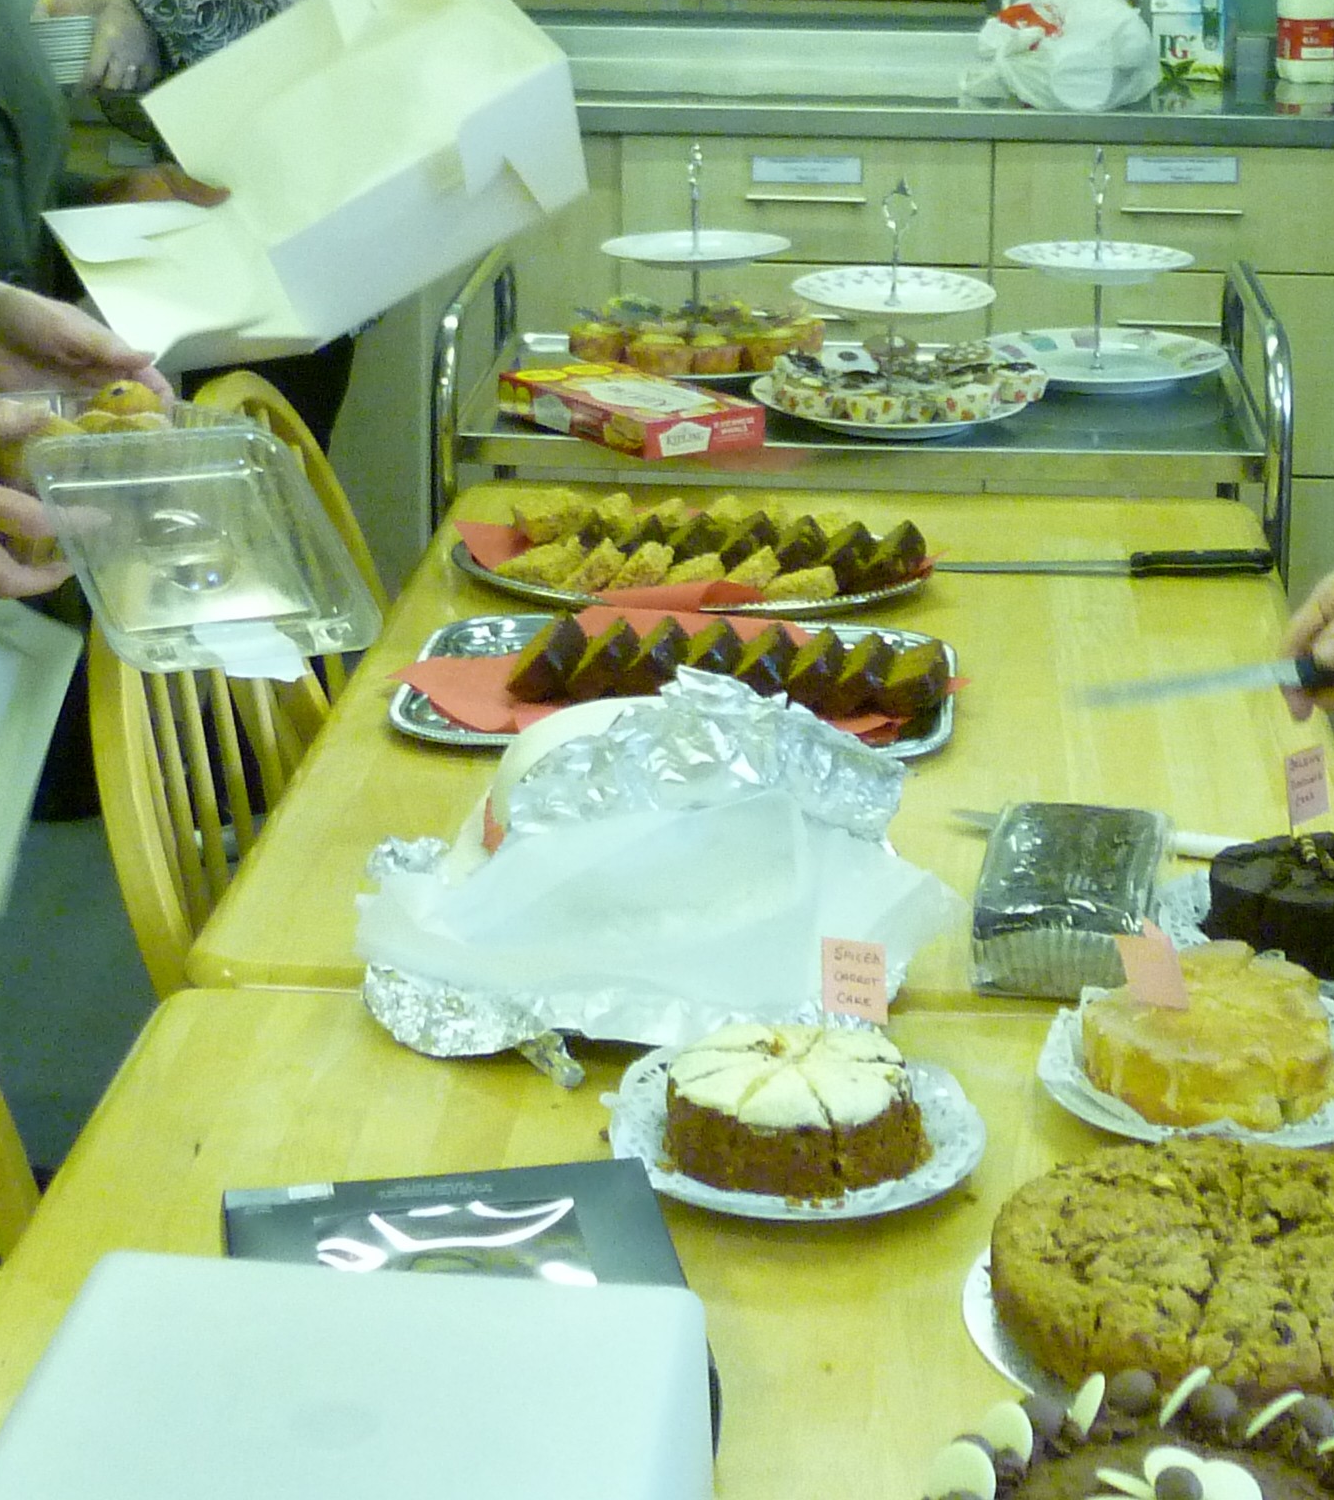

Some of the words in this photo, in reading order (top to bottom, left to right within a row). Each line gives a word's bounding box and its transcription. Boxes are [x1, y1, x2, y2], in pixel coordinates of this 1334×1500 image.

[1159, 34, 1189, 58] PG
[833, 970, 881, 987] CARROT
[836, 991, 872, 1007] CAKE
